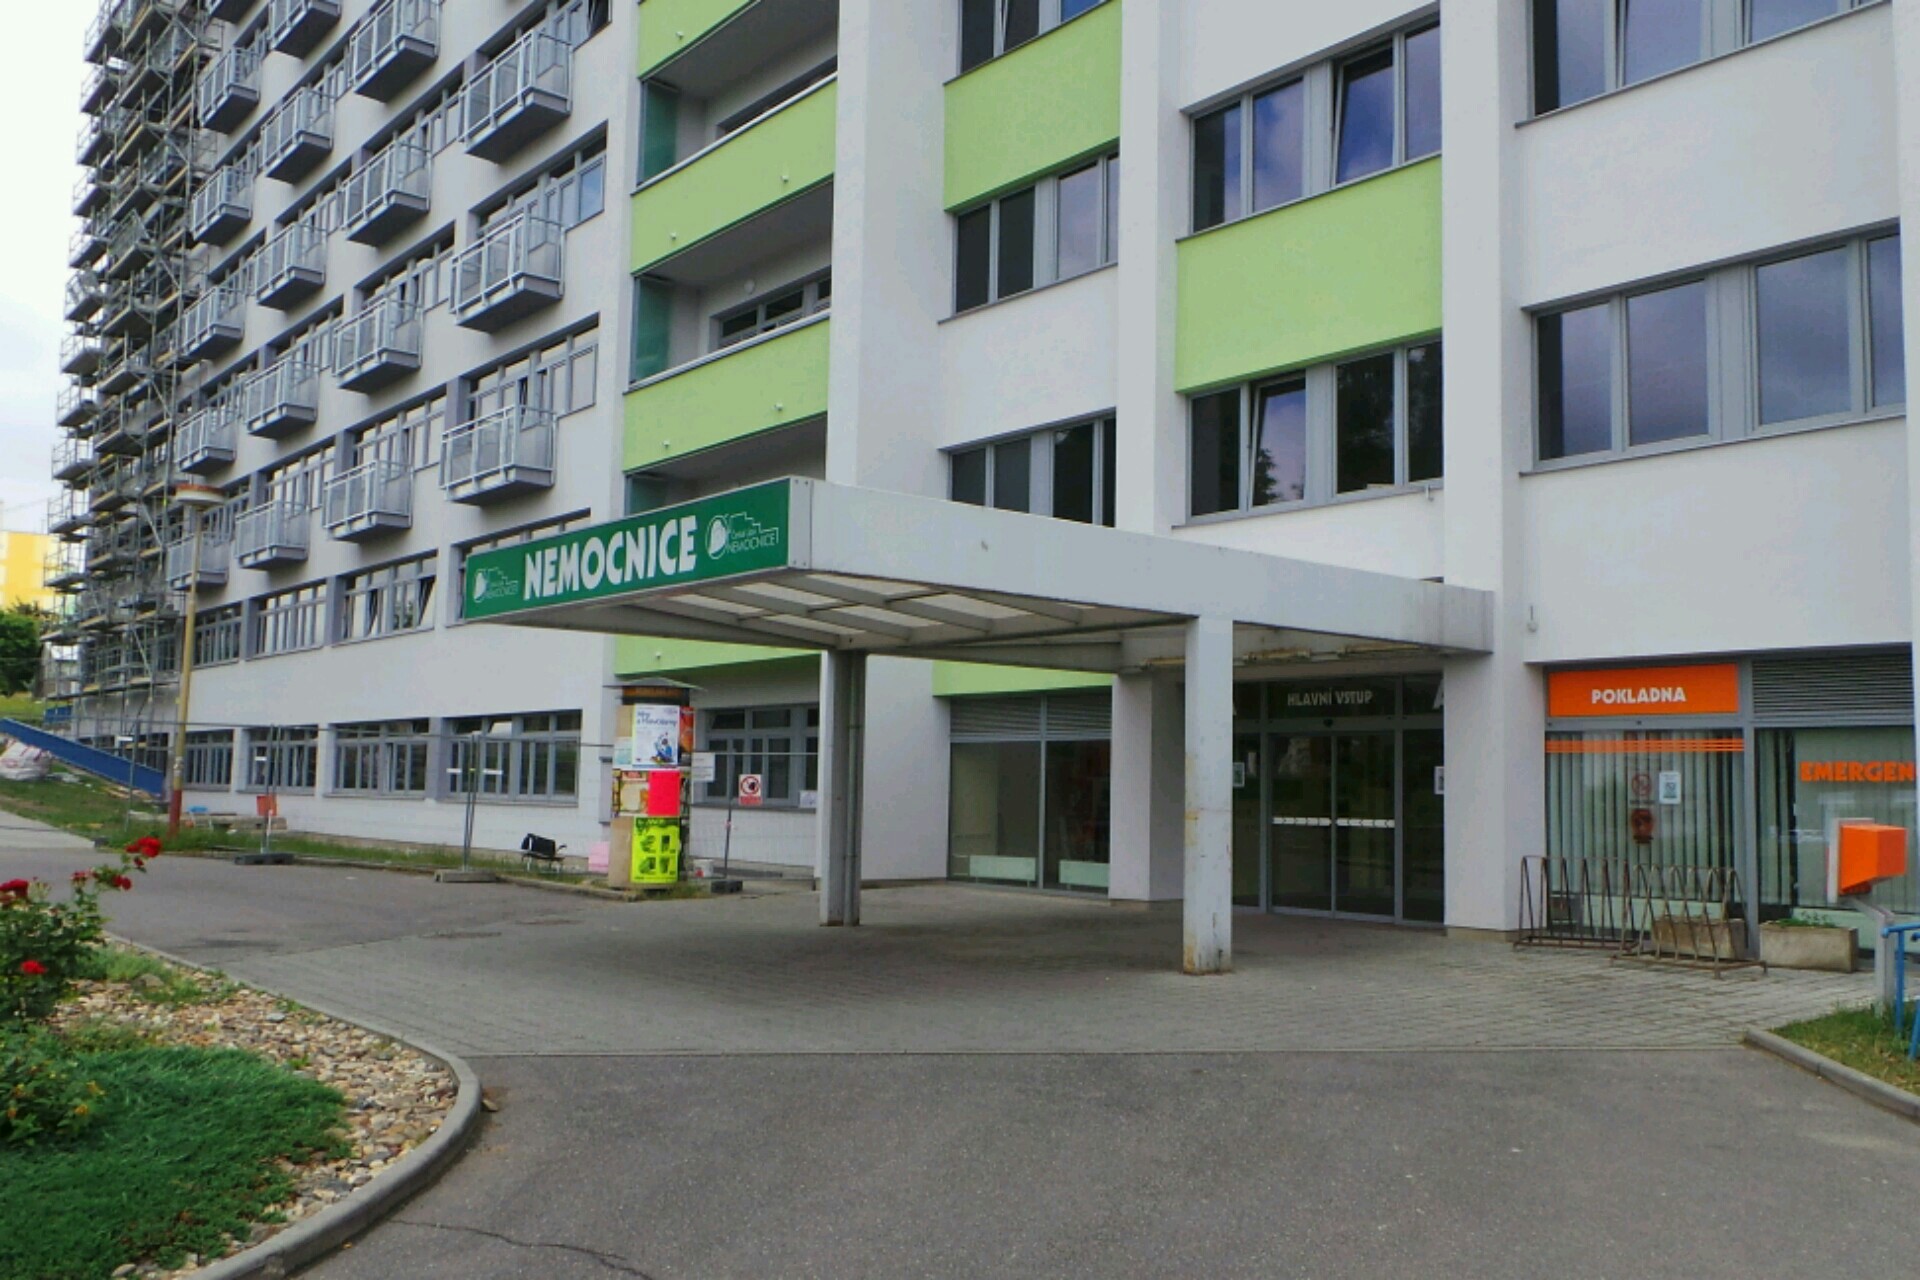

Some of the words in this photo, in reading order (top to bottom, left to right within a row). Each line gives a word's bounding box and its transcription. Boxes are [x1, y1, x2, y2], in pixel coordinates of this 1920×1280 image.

[524, 515, 697, 600] NEMOCNICE
[1287, 687, 1332, 706] HLAVNÍ
[1335, 691, 1374, 705] VSTUP
[1591, 687, 1687, 704] POKLADNA
[1800, 762, 1915, 782] EMERGEN
